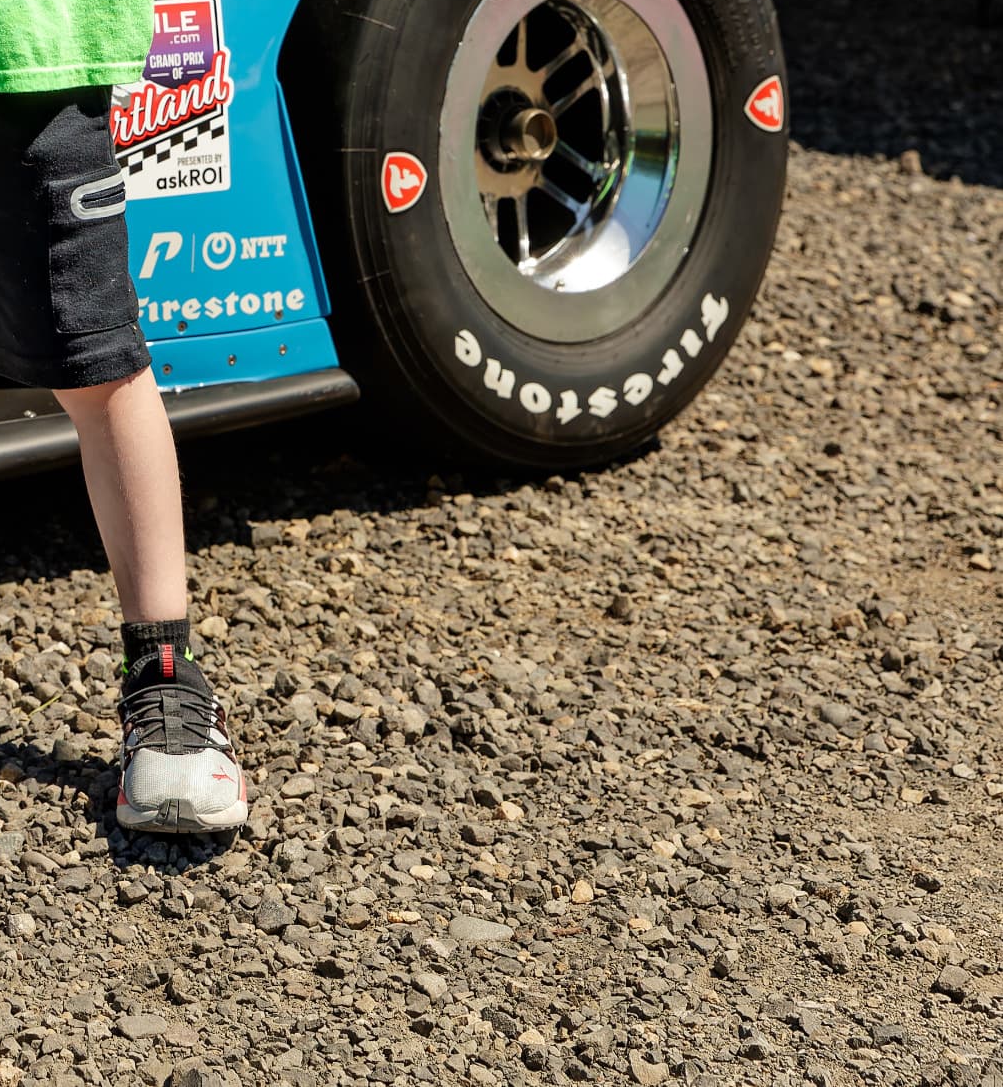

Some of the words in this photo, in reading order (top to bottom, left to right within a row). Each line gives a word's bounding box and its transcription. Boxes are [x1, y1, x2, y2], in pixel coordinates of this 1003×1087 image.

[169, 34, 201, 45] .com
[149, 53, 182, 69] GRAND
[182, 51, 205, 65] PRIX
[172, 67, 184, 80] OF
[177, 155, 213, 166] PRESENTED
[214, 153, 222, 163] BY
[156, 166, 223, 190] askROI
[240, 234, 288, 260] NTT
[453, 293, 730, 426] Firestone
